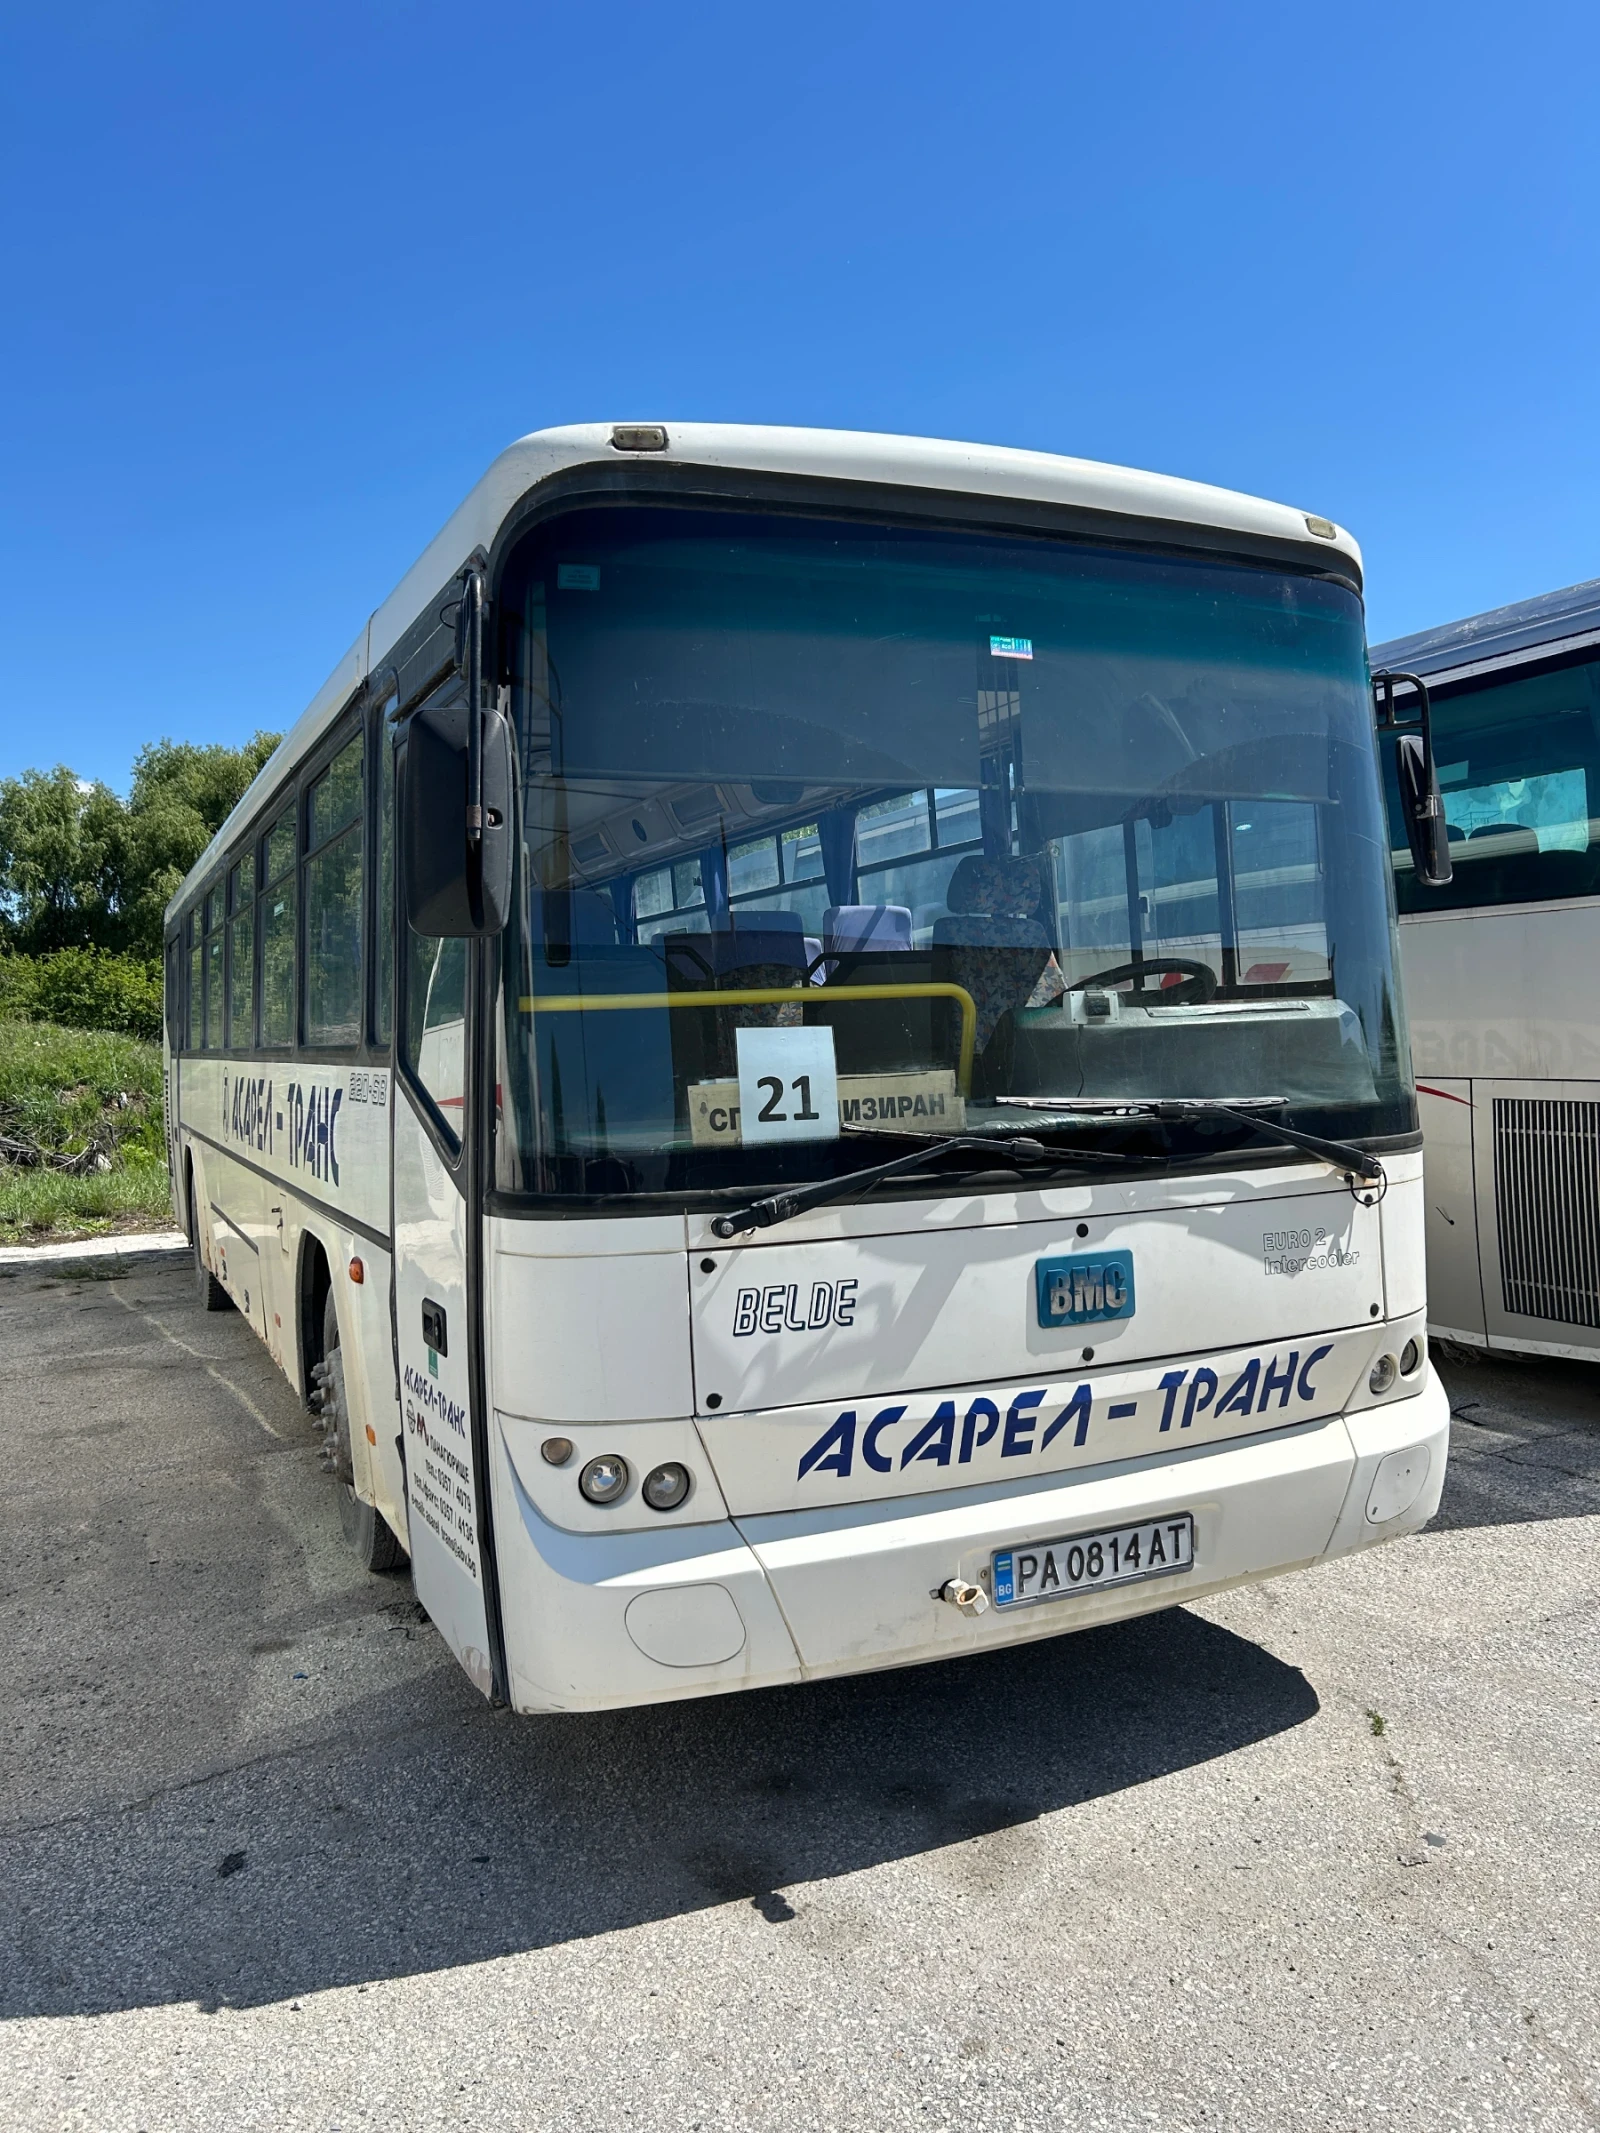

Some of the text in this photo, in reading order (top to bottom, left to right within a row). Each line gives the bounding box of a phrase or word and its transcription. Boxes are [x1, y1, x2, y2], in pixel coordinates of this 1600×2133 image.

[757, 1074, 820, 1123] 21
[232, 1075, 273, 1156] АСАРЕЛ
[287, 1082, 343, 1188] ТРАНС
[1263, 1227, 1326, 1252] EURO 2
[1264, 1248, 1360, 1276] Intercooler
[733, 1278, 859, 1338] BELDE
[1046, 1261, 1128, 1316] BMC
[797, 1383, 1093, 1482] АСАРЕЛ
[1157, 1343, 1335, 1432] ТРАНС
[1018, 1522, 1186, 1593] PA 0814 AT
[998, 1584, 1012, 1597] BG
